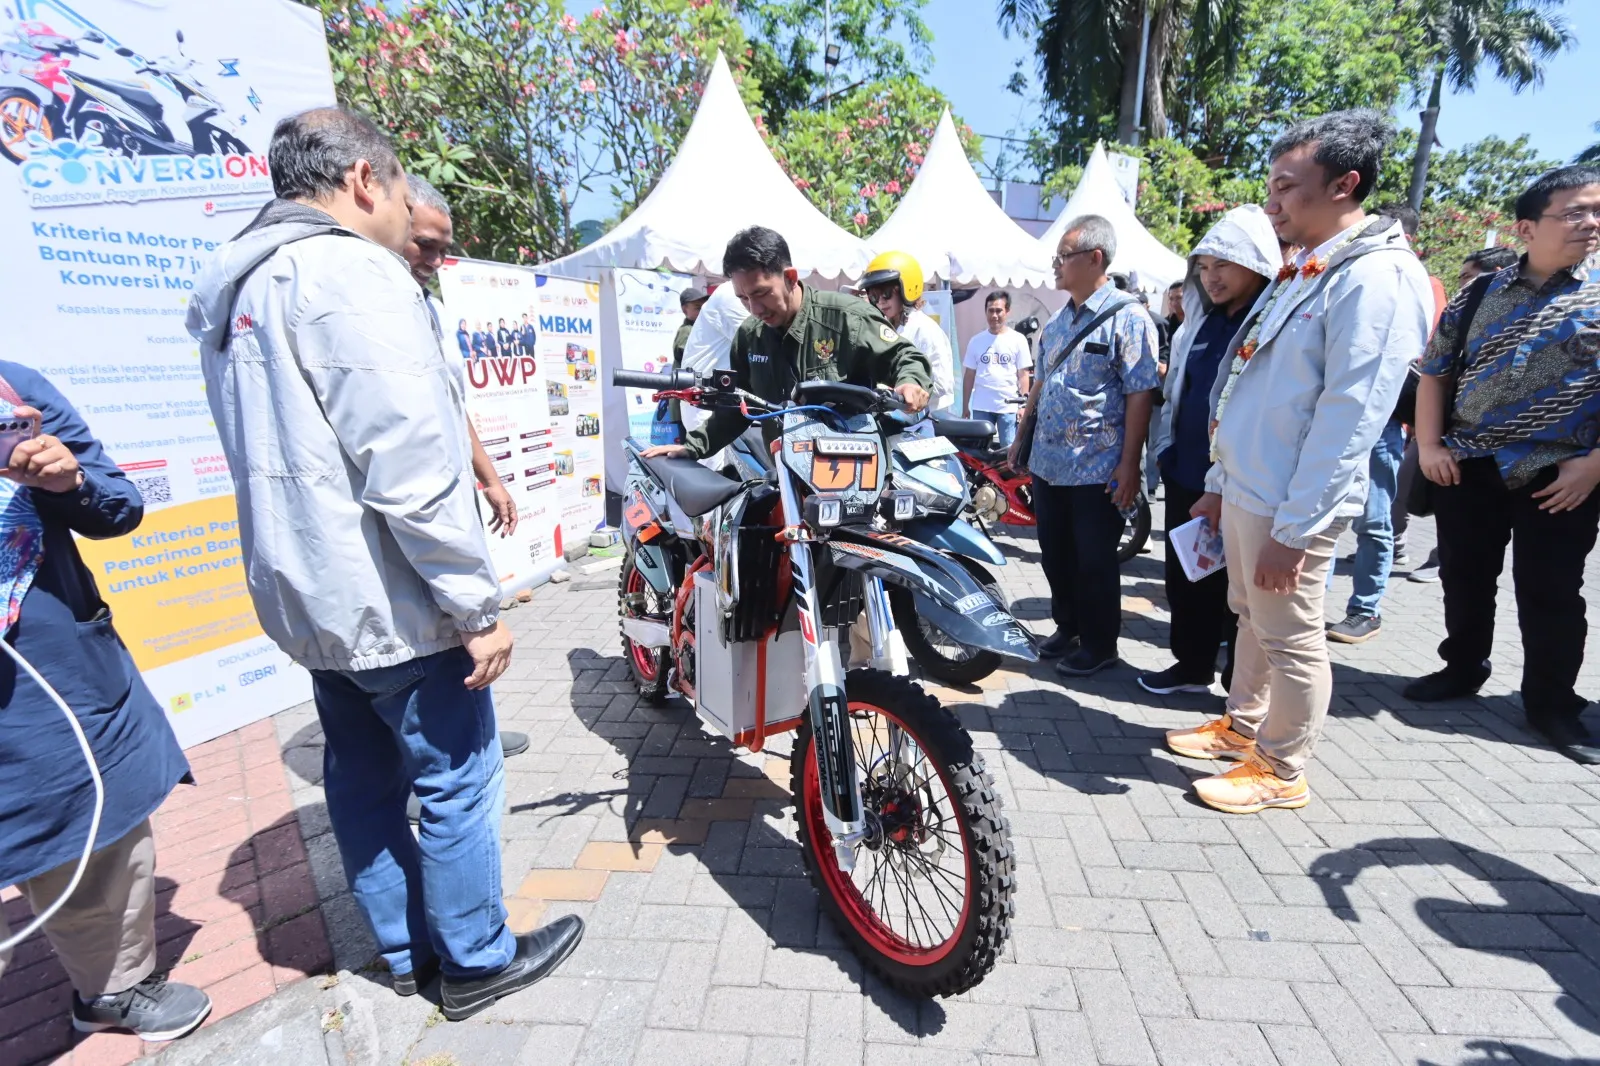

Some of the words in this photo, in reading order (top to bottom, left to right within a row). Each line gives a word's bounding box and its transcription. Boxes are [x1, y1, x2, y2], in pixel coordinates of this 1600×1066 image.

[32, 190, 102, 204] Roadshow
[106, 187, 157, 200] Program
[161, 184, 208, 196] Konversi
[31, 221, 122, 244] Kriteria
[127, 230, 187, 250] Motor
[38, 245, 141, 267] Bantuan
[59, 270, 160, 289] Konversi
[164, 275, 194, 290] Mo
[56, 304, 120, 317] Kapasitas
[123, 306, 158, 316] mesin
[539, 314, 593, 335] MBKM
[40, 366, 89, 377] Kondisi
[121, 364, 166, 376] lengkap
[71, 374, 147, 386] berdasarkan
[466, 357, 537, 389] UWP
[84, 404, 123, 415] Tanda
[124, 402, 164, 411] Nomor
[132, 525, 205, 549] Kriteria
[104, 545, 203, 575] Penerima
[206, 538, 241, 552] Ban
[109, 571, 170, 593] untuk
[217, 643, 277, 668] DIDUKUNG
[254, 664, 277, 680] BRI
